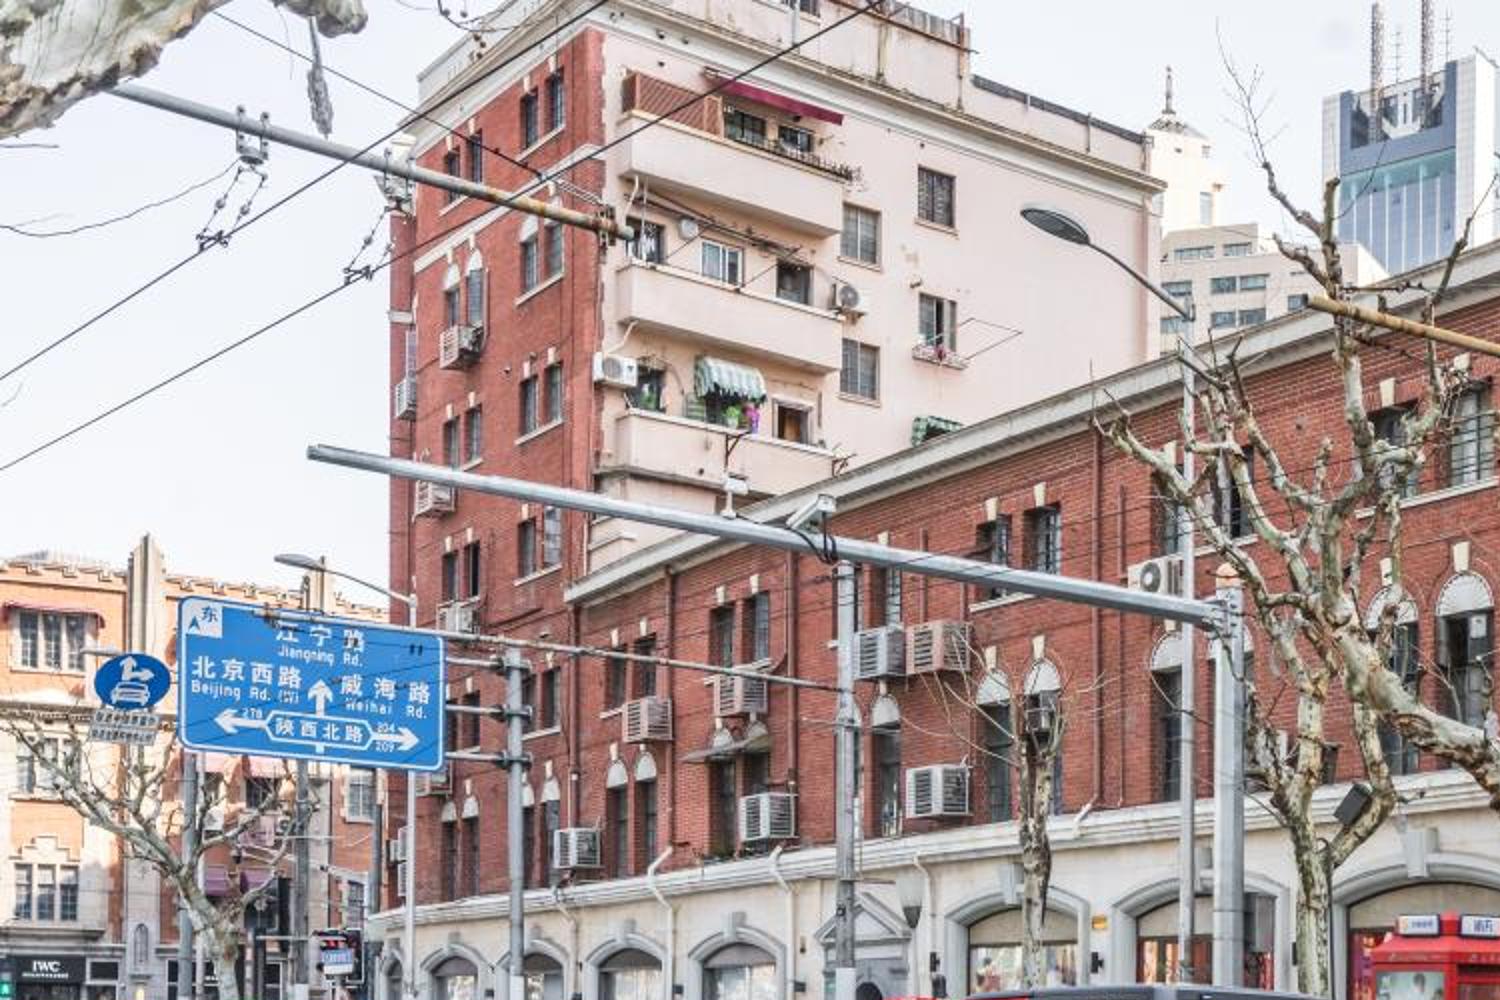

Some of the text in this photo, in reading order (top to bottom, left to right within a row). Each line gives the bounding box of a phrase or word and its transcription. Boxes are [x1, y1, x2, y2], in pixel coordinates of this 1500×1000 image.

[201, 606, 219, 622] 东
[275, 620, 365, 653] 江宁路
[278, 644, 363, 667] Jiangning Rd.
[191, 656, 302, 689] 北京西路
[191, 679, 241, 701] Beijing
[250, 685, 271, 701] Rd.
[340, 673, 430, 705] 威海路
[406, 704, 427, 719] Rd.
[275, 717, 363, 744] 陕西北路
[33, 961, 61, 973] IWC
